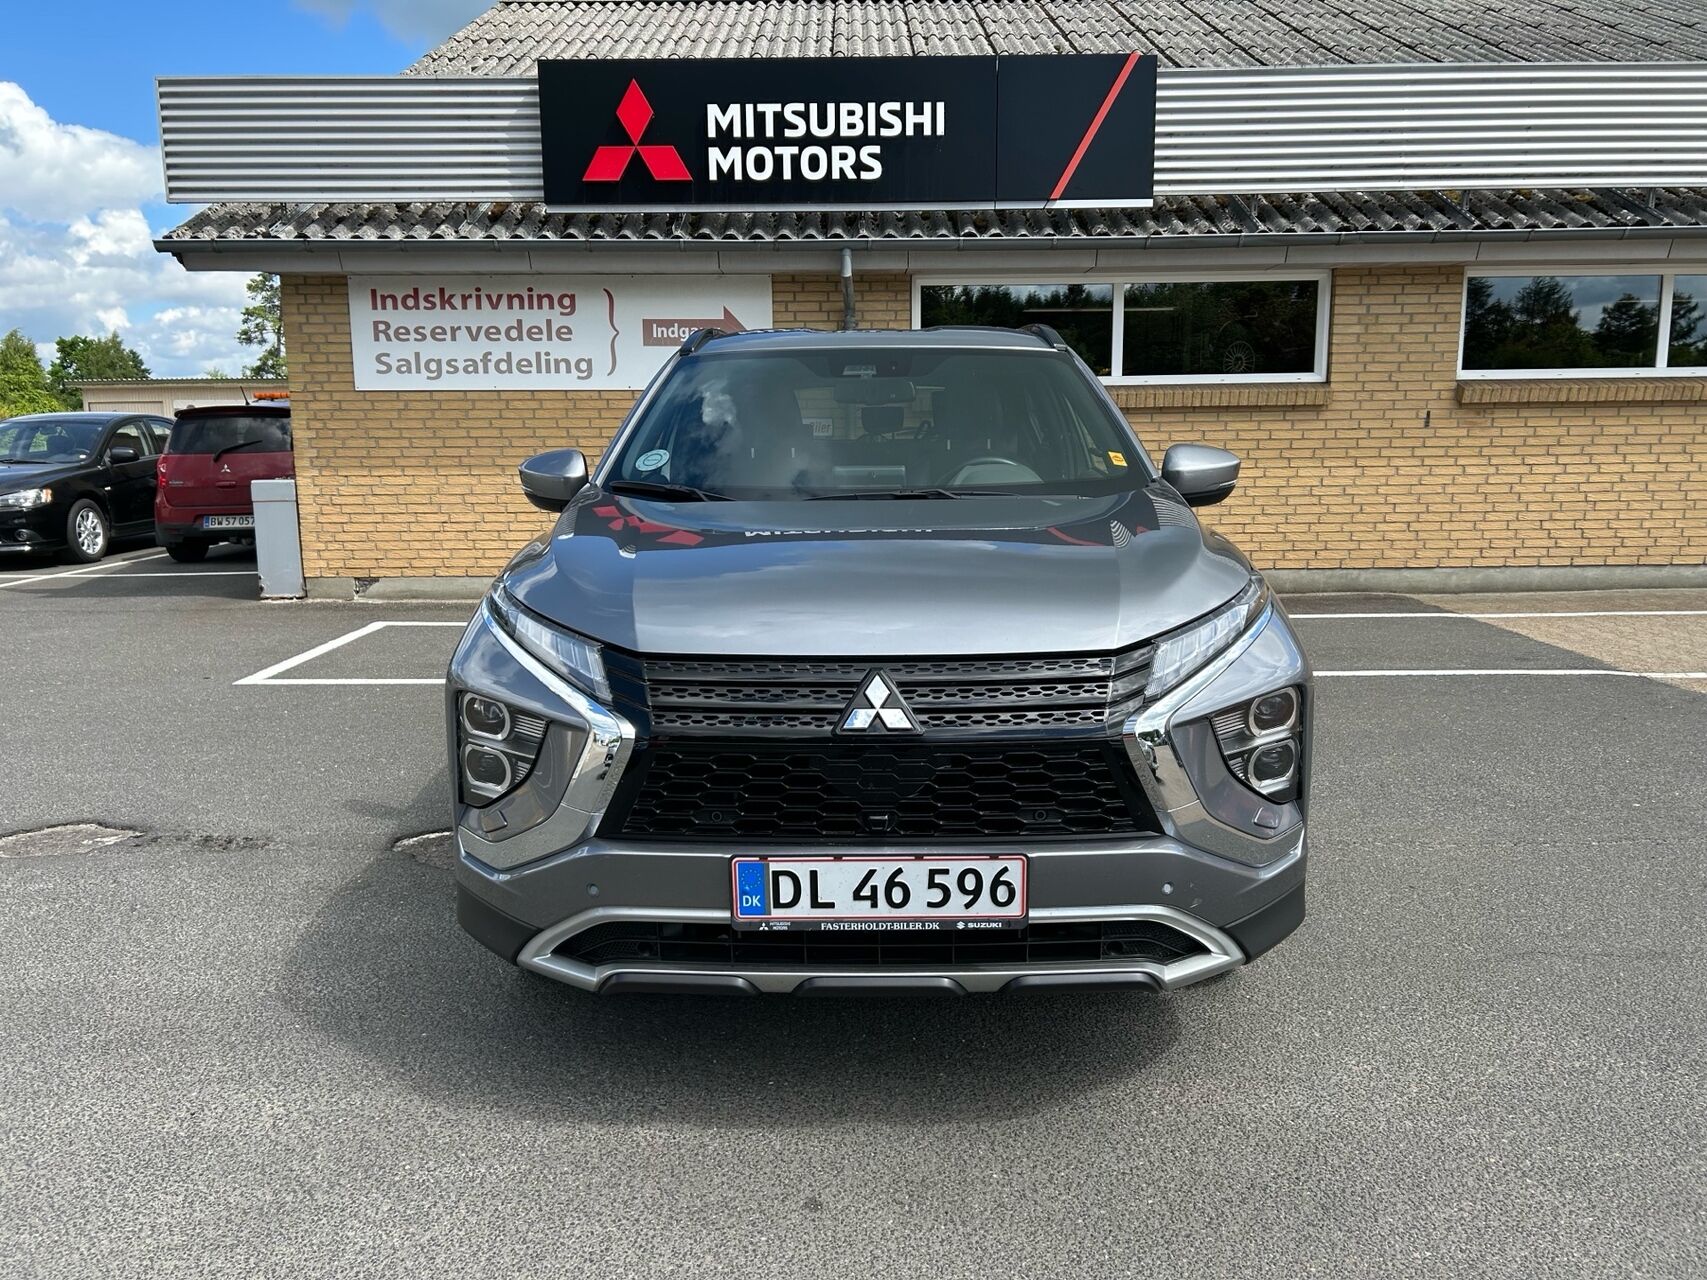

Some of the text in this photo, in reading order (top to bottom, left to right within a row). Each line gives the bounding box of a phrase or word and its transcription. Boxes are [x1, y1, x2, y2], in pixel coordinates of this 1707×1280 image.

[706, 101, 945, 138] MITSUBISHI
[707, 145, 883, 181] MOTORS
[370, 286, 577, 316] Indskrivning
[372, 318, 573, 342] Reservedele
[375, 351, 593, 380] Salgsafdeling
[225, 516, 237, 526] 57
[742, 895, 761, 907] DK
[771, 866, 1017, 910] DL 46 596
[821, 922, 940, 931] FASTERHOLDT-BILER.DK
